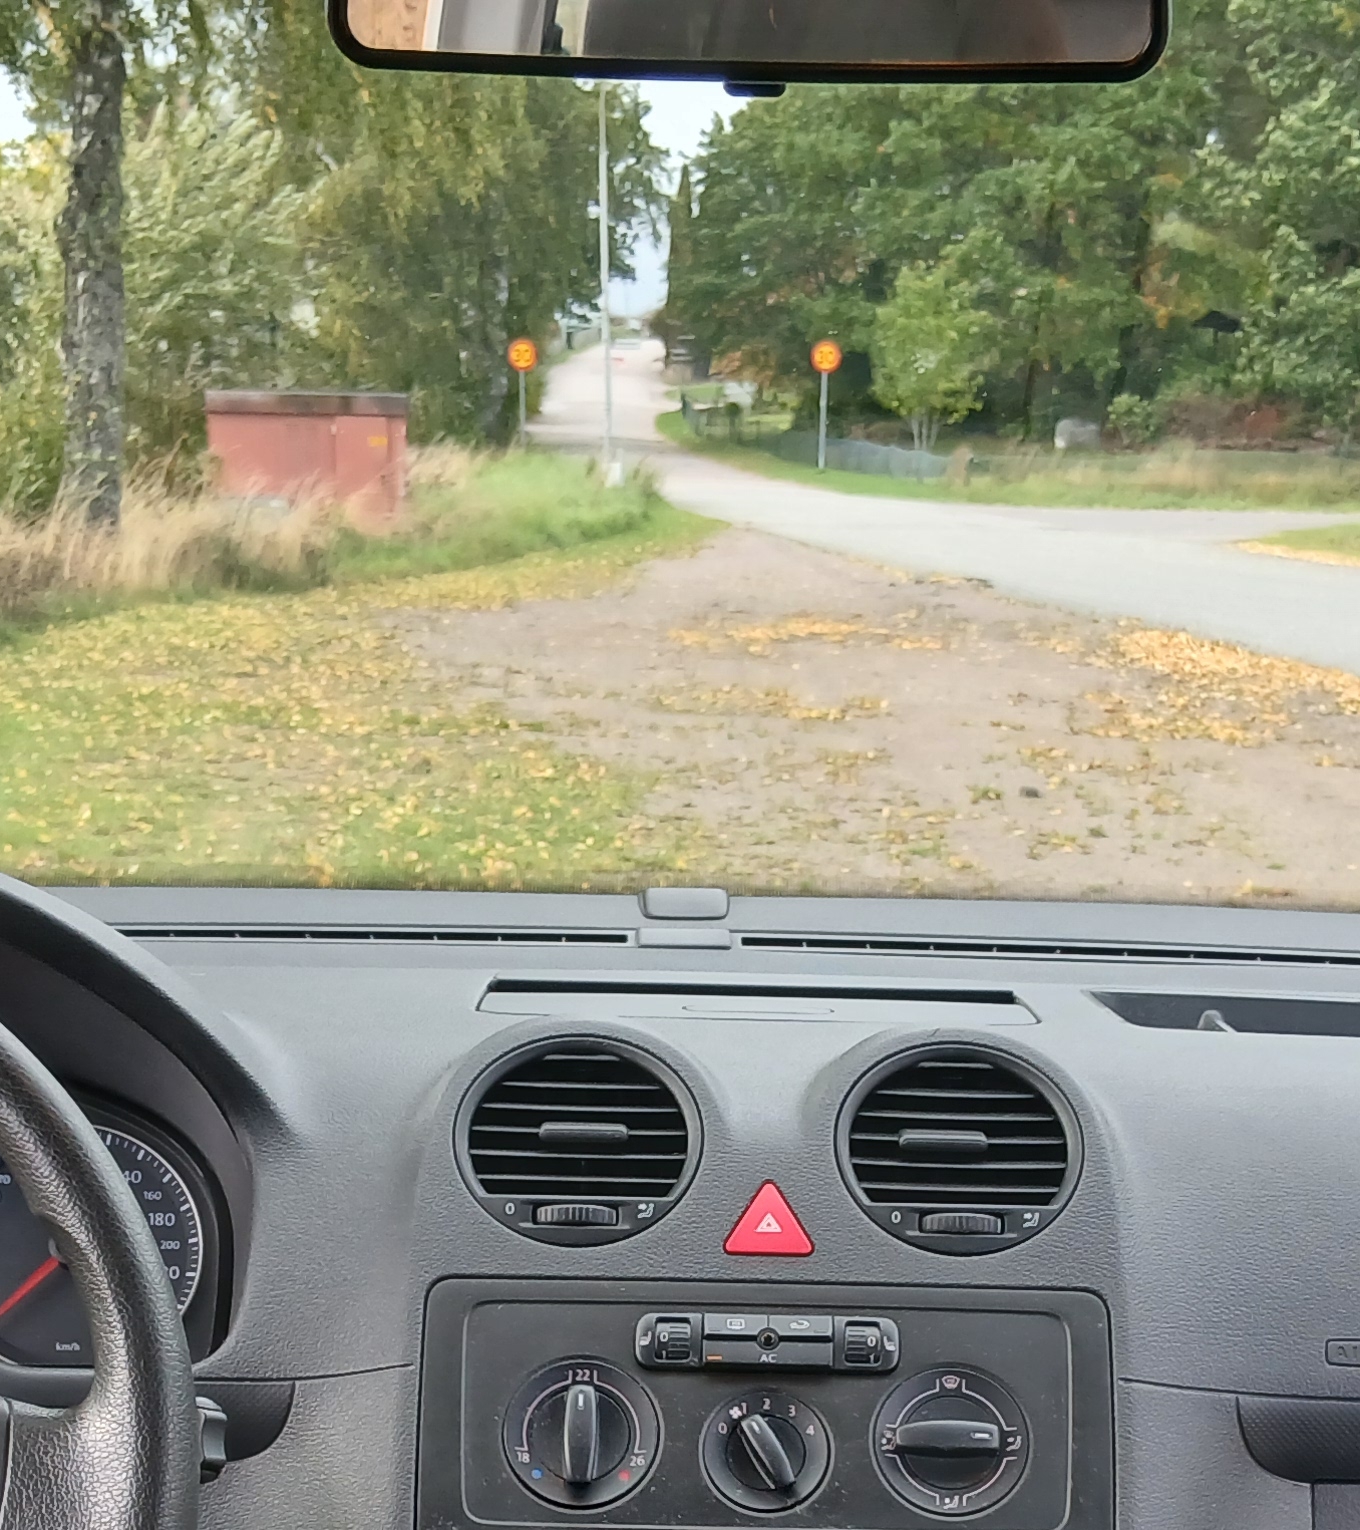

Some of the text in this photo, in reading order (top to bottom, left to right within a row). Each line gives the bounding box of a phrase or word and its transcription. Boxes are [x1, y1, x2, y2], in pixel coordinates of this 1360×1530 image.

[123, 1169, 142, 1184] 40
[143, 1190, 162, 1201] 160
[505, 1202, 516, 1215] 0
[147, 1212, 176, 1227] 180
[891, 1210, 902, 1224] 0
[159, 1239, 181, 1250] 200
[659, 1331, 669, 1342] 0
[867, 1336, 877, 1347] 0
[55, 1342, 81, 1351] km/h
[759, 1353, 778, 1364] AC
[575, 1369, 591, 1381] 22
[741, 1402, 747, 1415] 1
[762, 1398, 771, 1410] 2
[788, 1405, 796, 1417] 3
[718, 1422, 728, 1434] 0
[805, 1424, 815, 1436] 4
[517, 1452, 530, 1464] 18
[629, 1455, 646, 1466] 26
